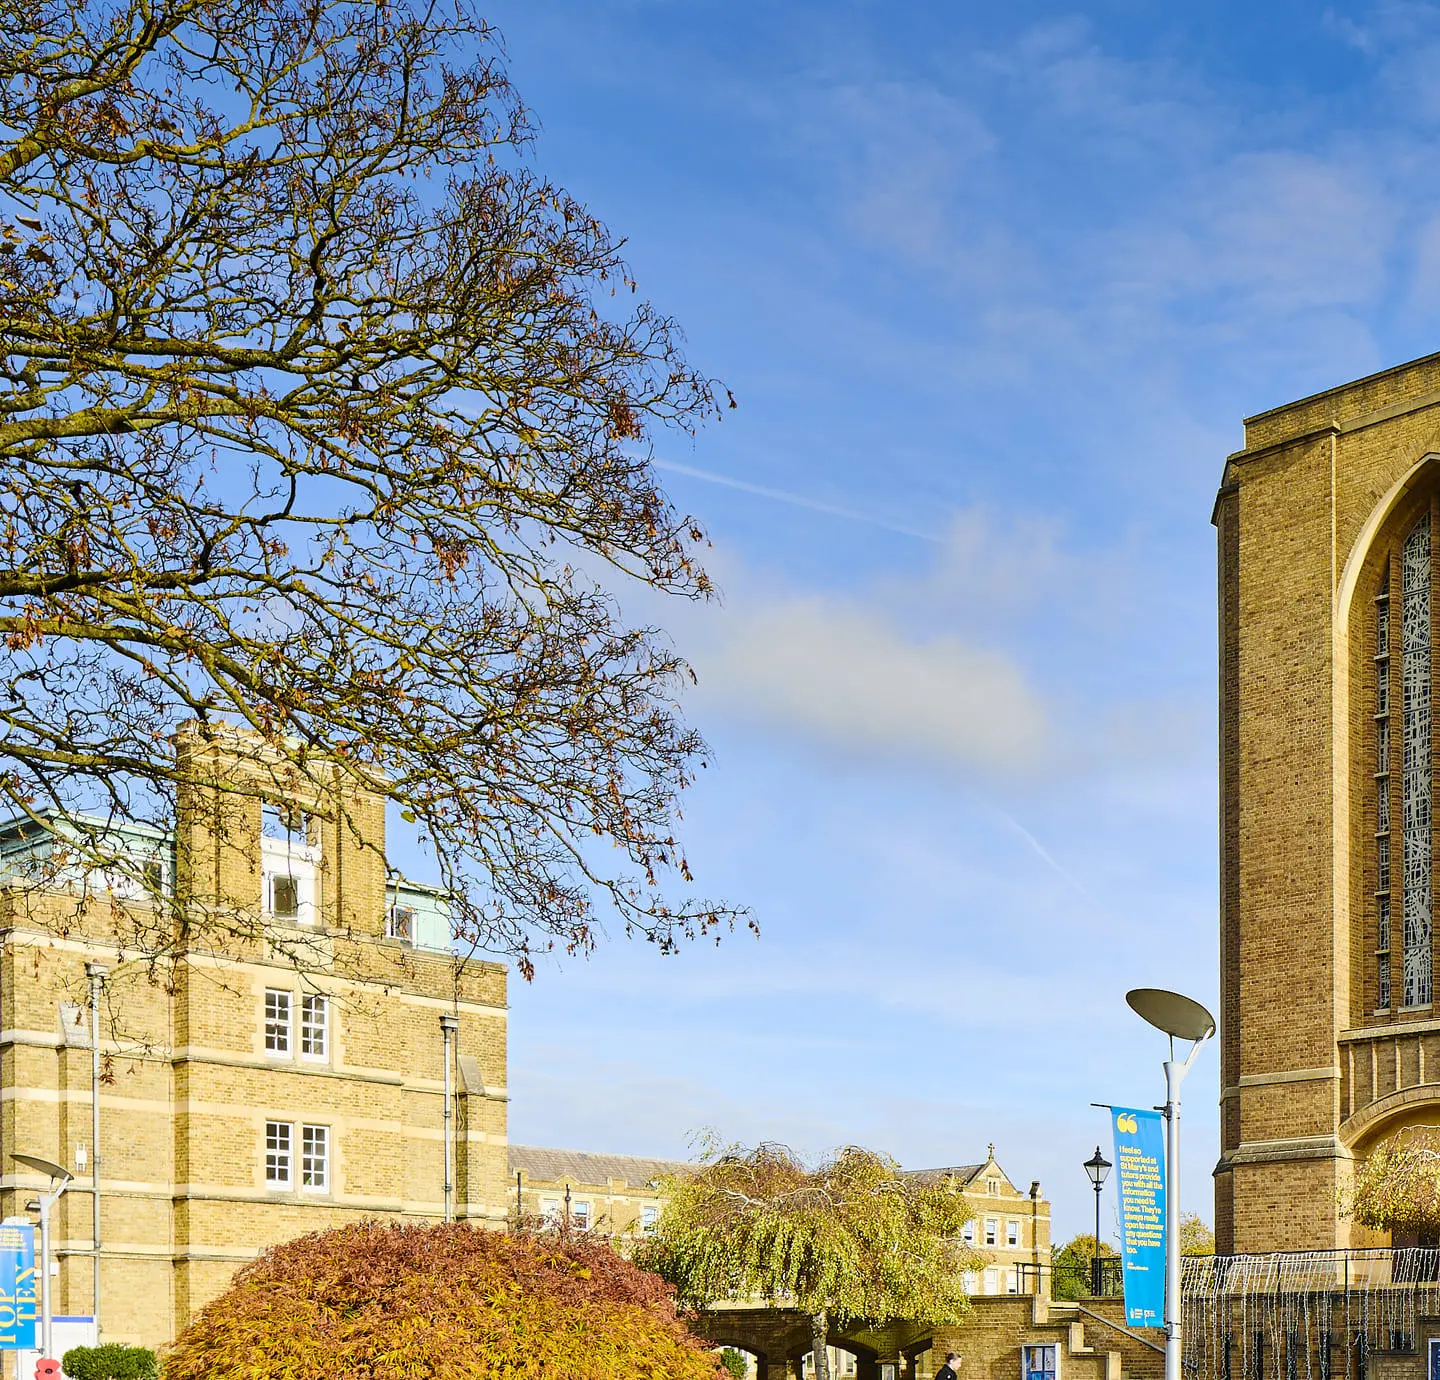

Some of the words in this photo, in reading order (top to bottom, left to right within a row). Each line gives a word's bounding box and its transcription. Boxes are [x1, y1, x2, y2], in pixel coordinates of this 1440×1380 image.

[1120, 1156, 1150, 1164] supported
[1121, 1171, 1138, 1179] tutors
[1139, 1173, 1160, 1182] provide
[1122, 1188, 1155, 1196] information
[1124, 1213, 1143, 1222] always
[1144, 1214, 1158, 1223] really
[1125, 1231, 1135, 1239] any
[1136, 1231, 1162, 1239] questions
[1148, 1239, 1160, 1247] have
